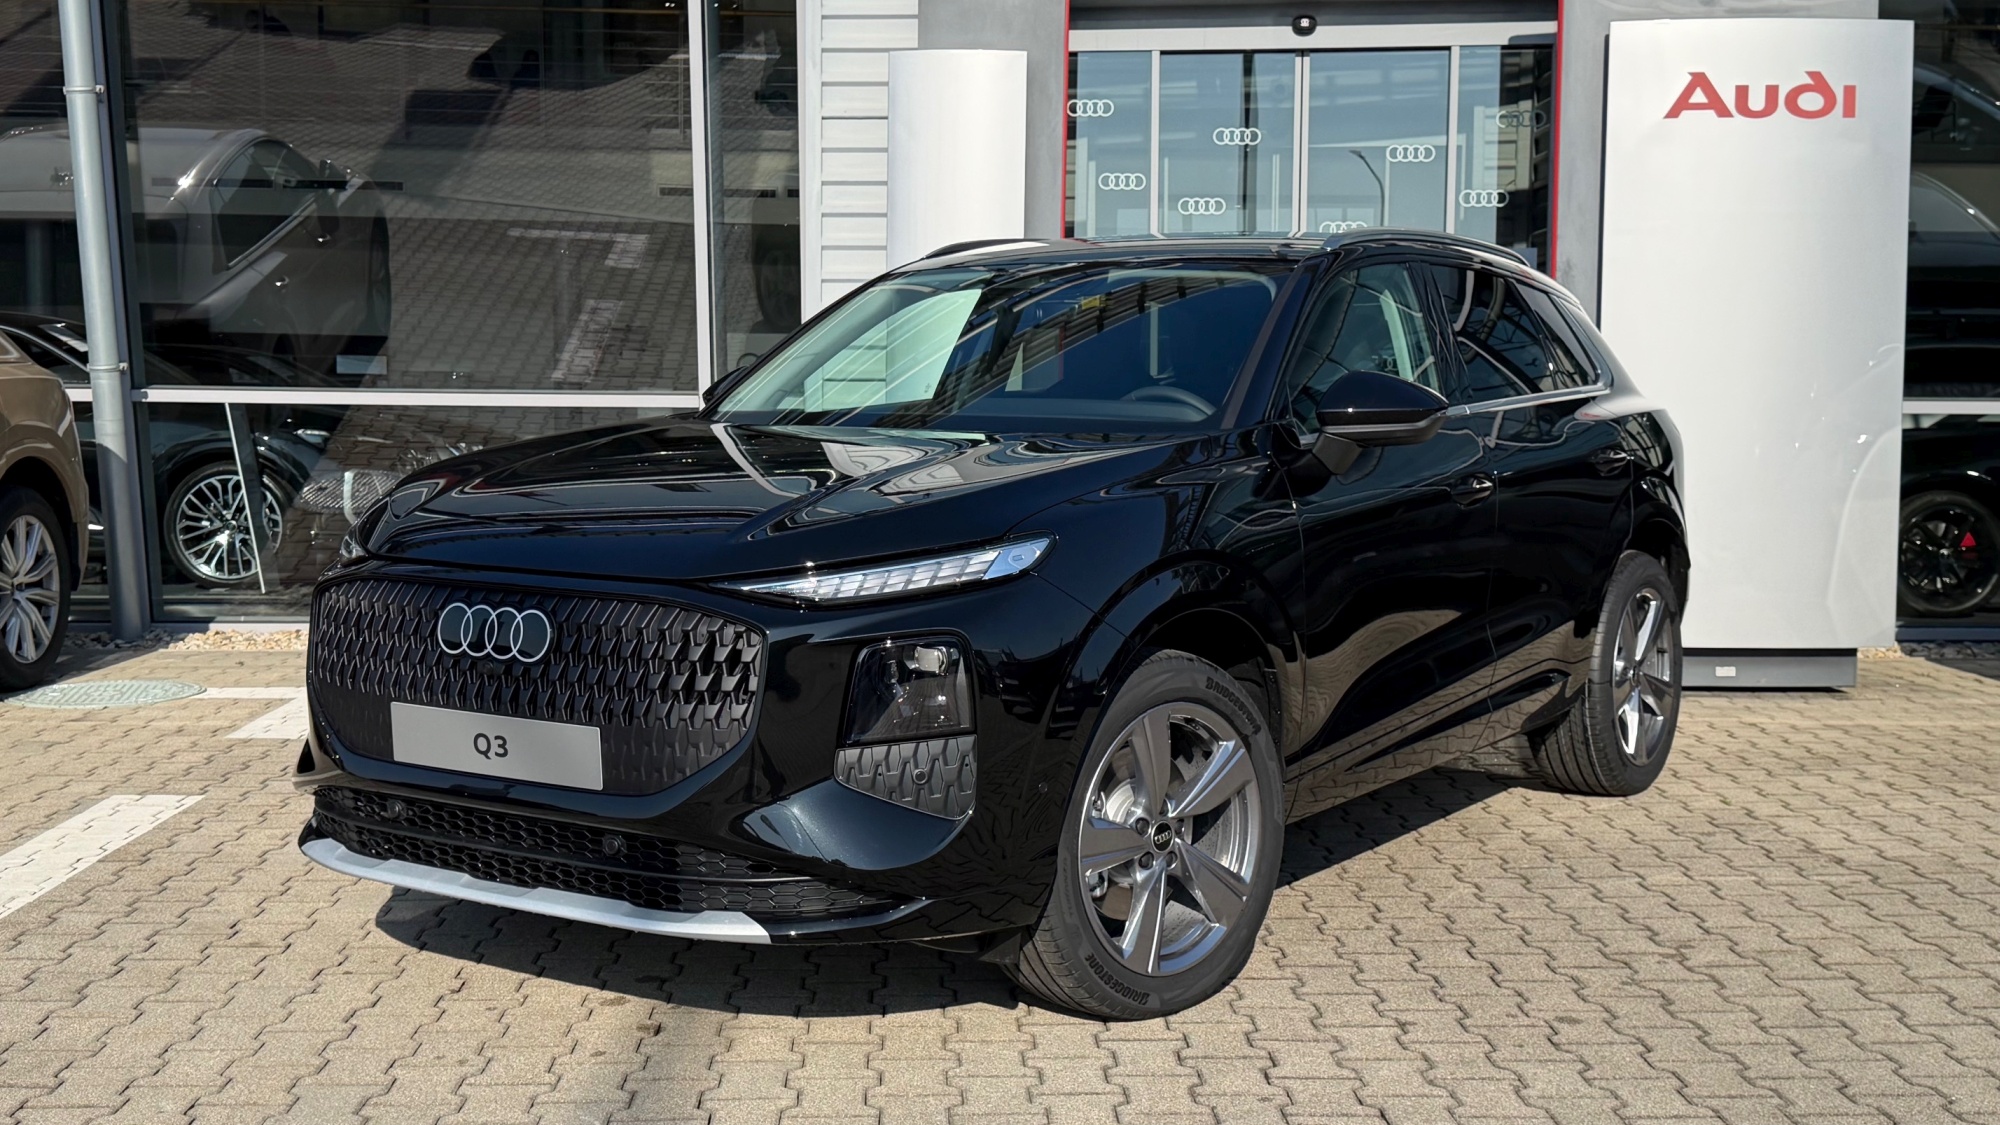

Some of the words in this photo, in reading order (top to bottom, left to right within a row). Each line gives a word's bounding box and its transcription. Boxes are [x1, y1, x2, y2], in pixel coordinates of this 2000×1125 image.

[1662, 71, 1857, 119] Audi
[473, 732, 509, 760] Q3
[1084, 952, 1150, 1006] BRIDGESTONE
